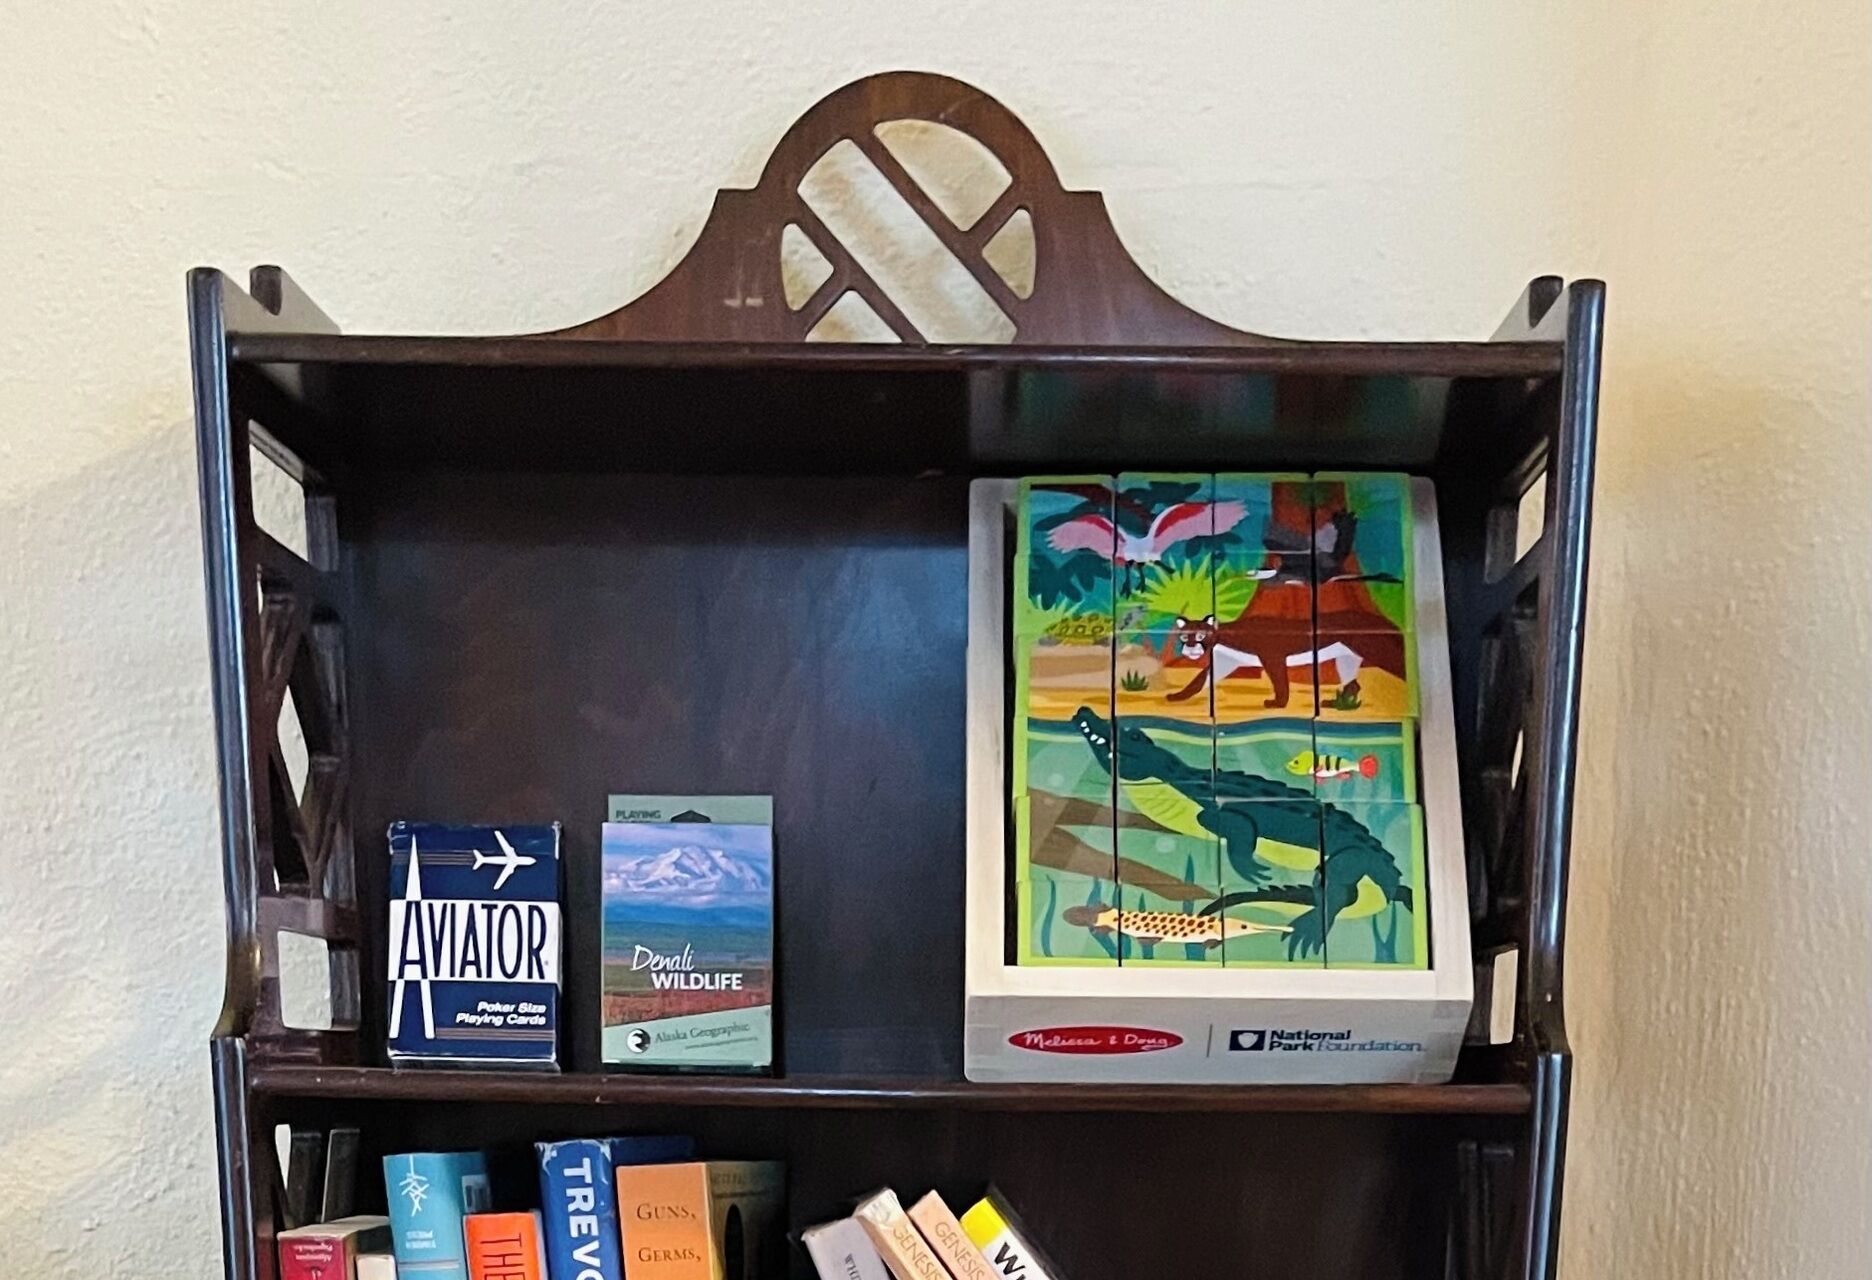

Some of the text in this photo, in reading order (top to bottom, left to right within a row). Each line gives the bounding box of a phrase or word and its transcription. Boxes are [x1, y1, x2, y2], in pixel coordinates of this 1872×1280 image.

[615, 810, 661, 819] PLAYING
[631, 943, 695, 973] Denali
[651, 971, 743, 990] WILDLIFE
[477, 1001, 547, 1014] Poker Size
[455, 1013, 546, 1027] Playing Cards
[655, 1030, 688, 1044] Alaska
[1024, 1032, 1102, 1049] Melissa
[1123, 1033, 1168, 1050] Doug
[1270, 1030, 1352, 1041] National
[1268, 1040, 1314, 1052] Park
[636, 1203, 697, 1223] GUNS,
[638, 1246, 702, 1263] GERMS,
